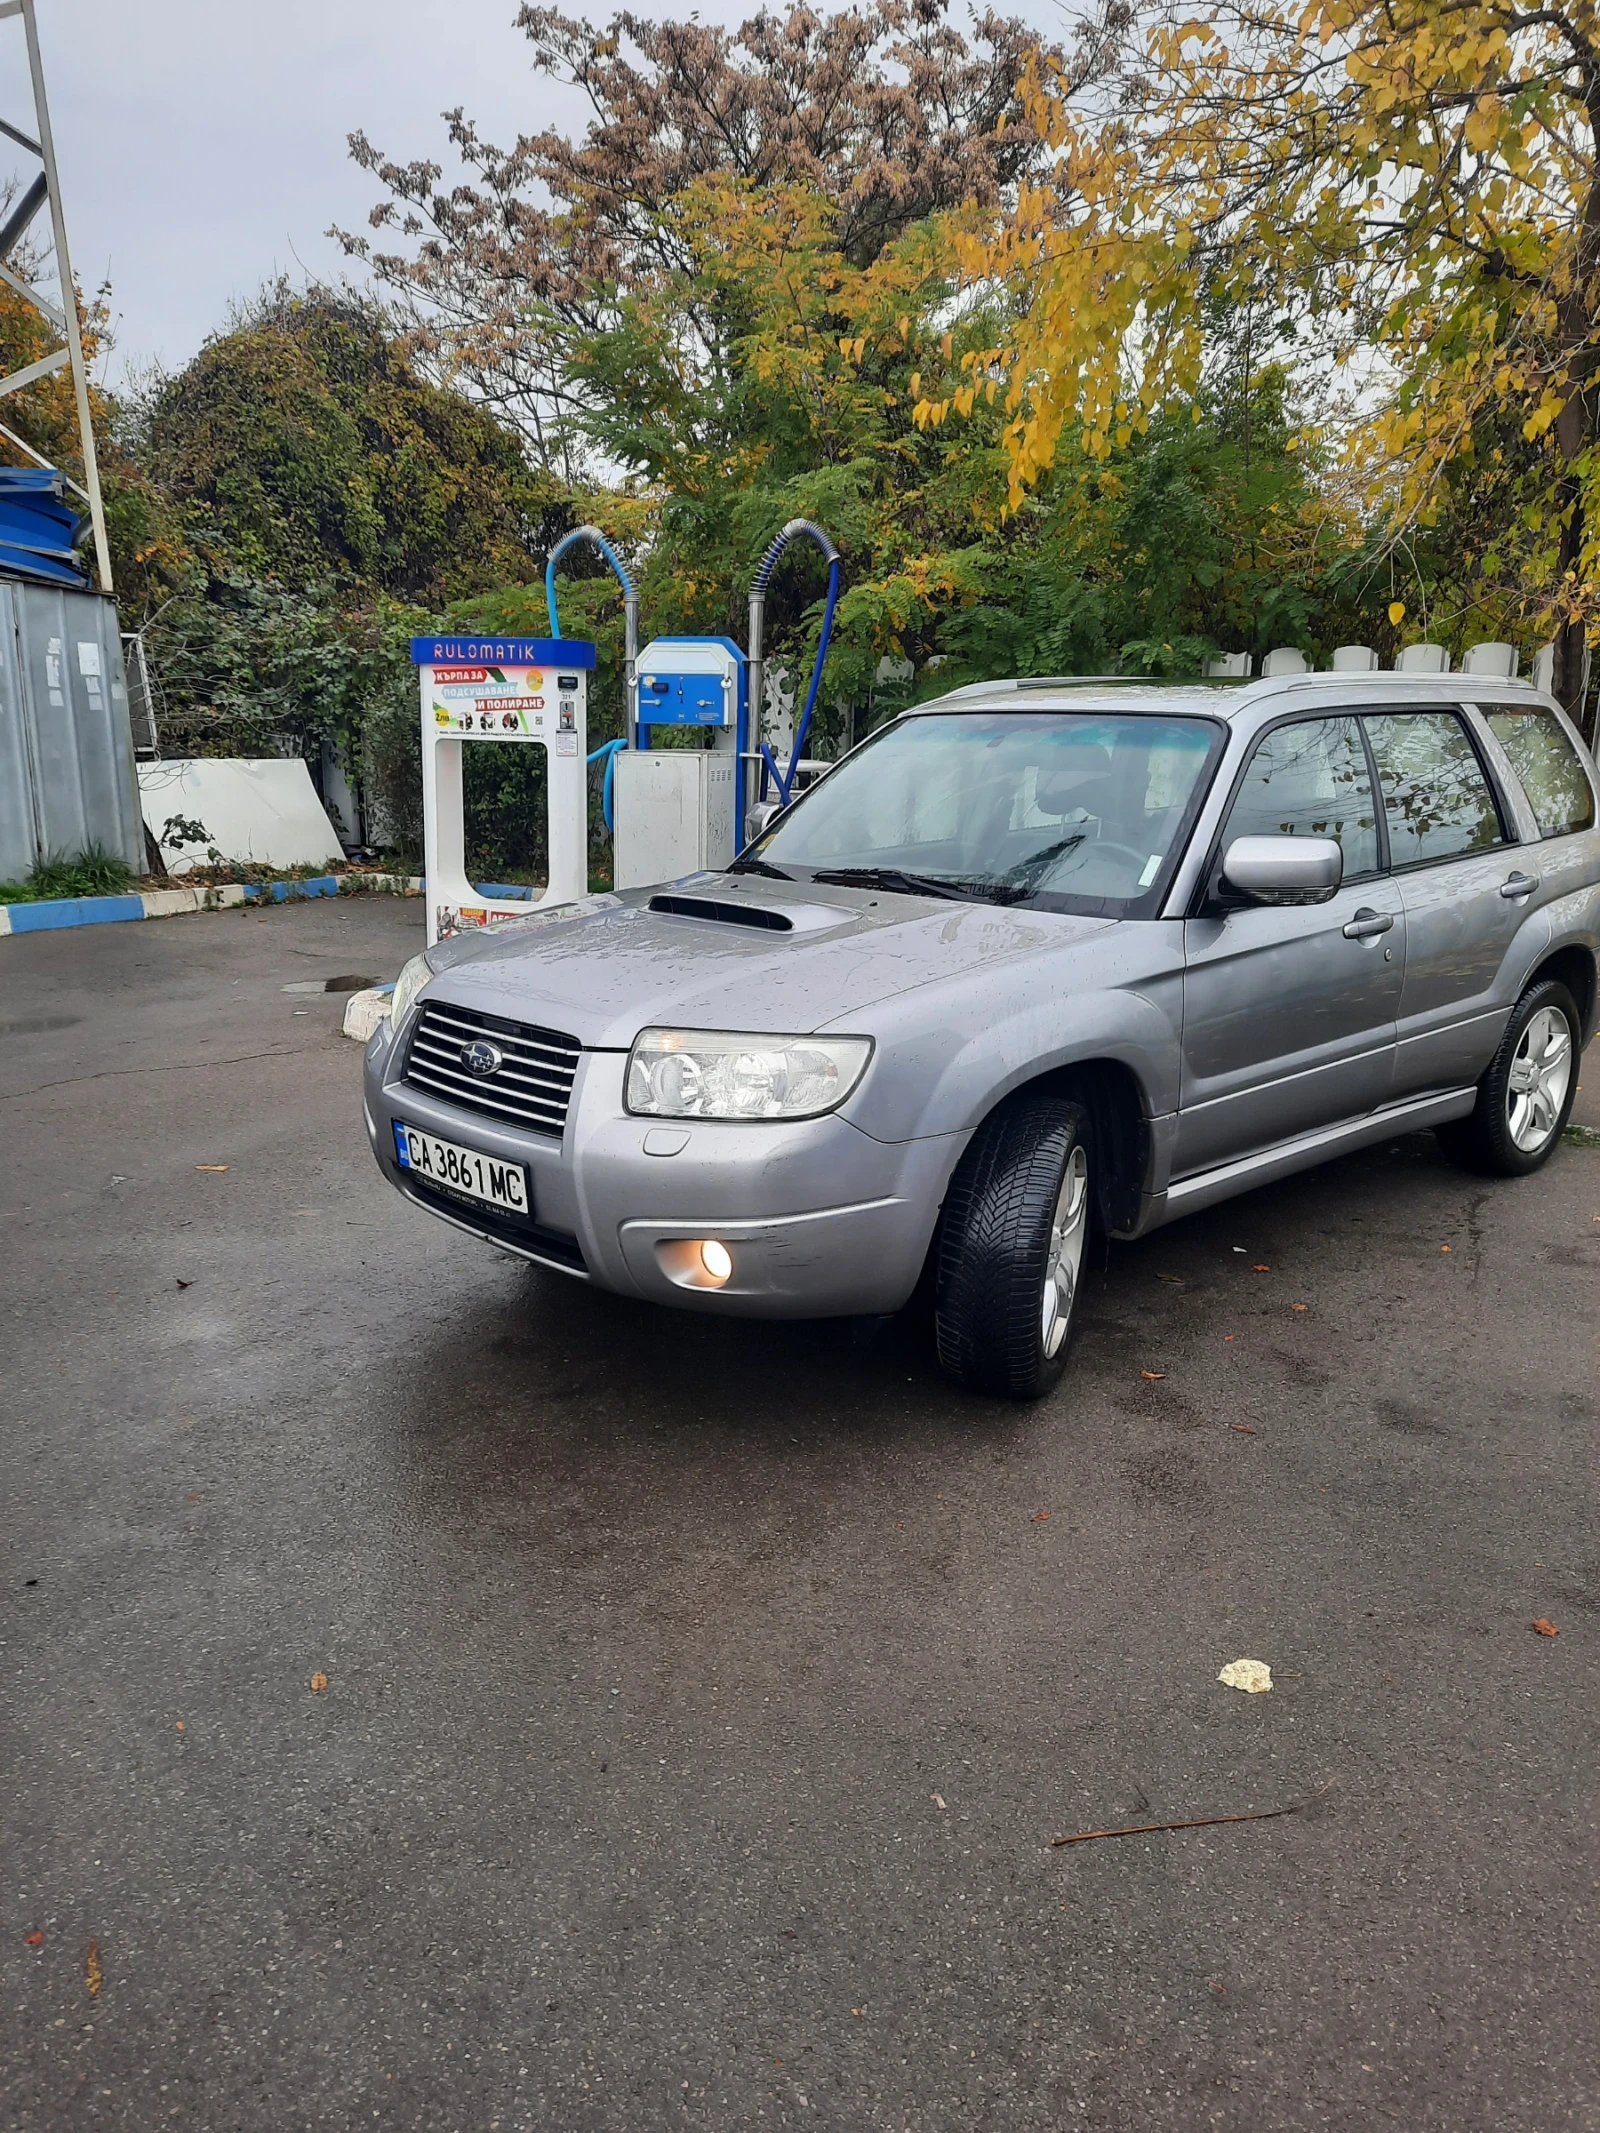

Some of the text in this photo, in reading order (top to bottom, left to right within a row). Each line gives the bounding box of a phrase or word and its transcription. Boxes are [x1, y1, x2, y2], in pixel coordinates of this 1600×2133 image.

[436, 670, 484, 681] КЪРПА ЗА
[443, 685, 516, 698] ПОДСУШАВАНЕ
[477, 698, 543, 710] И ПОЛИРАНЕ
[435, 1143, 485, 1195] 3861
